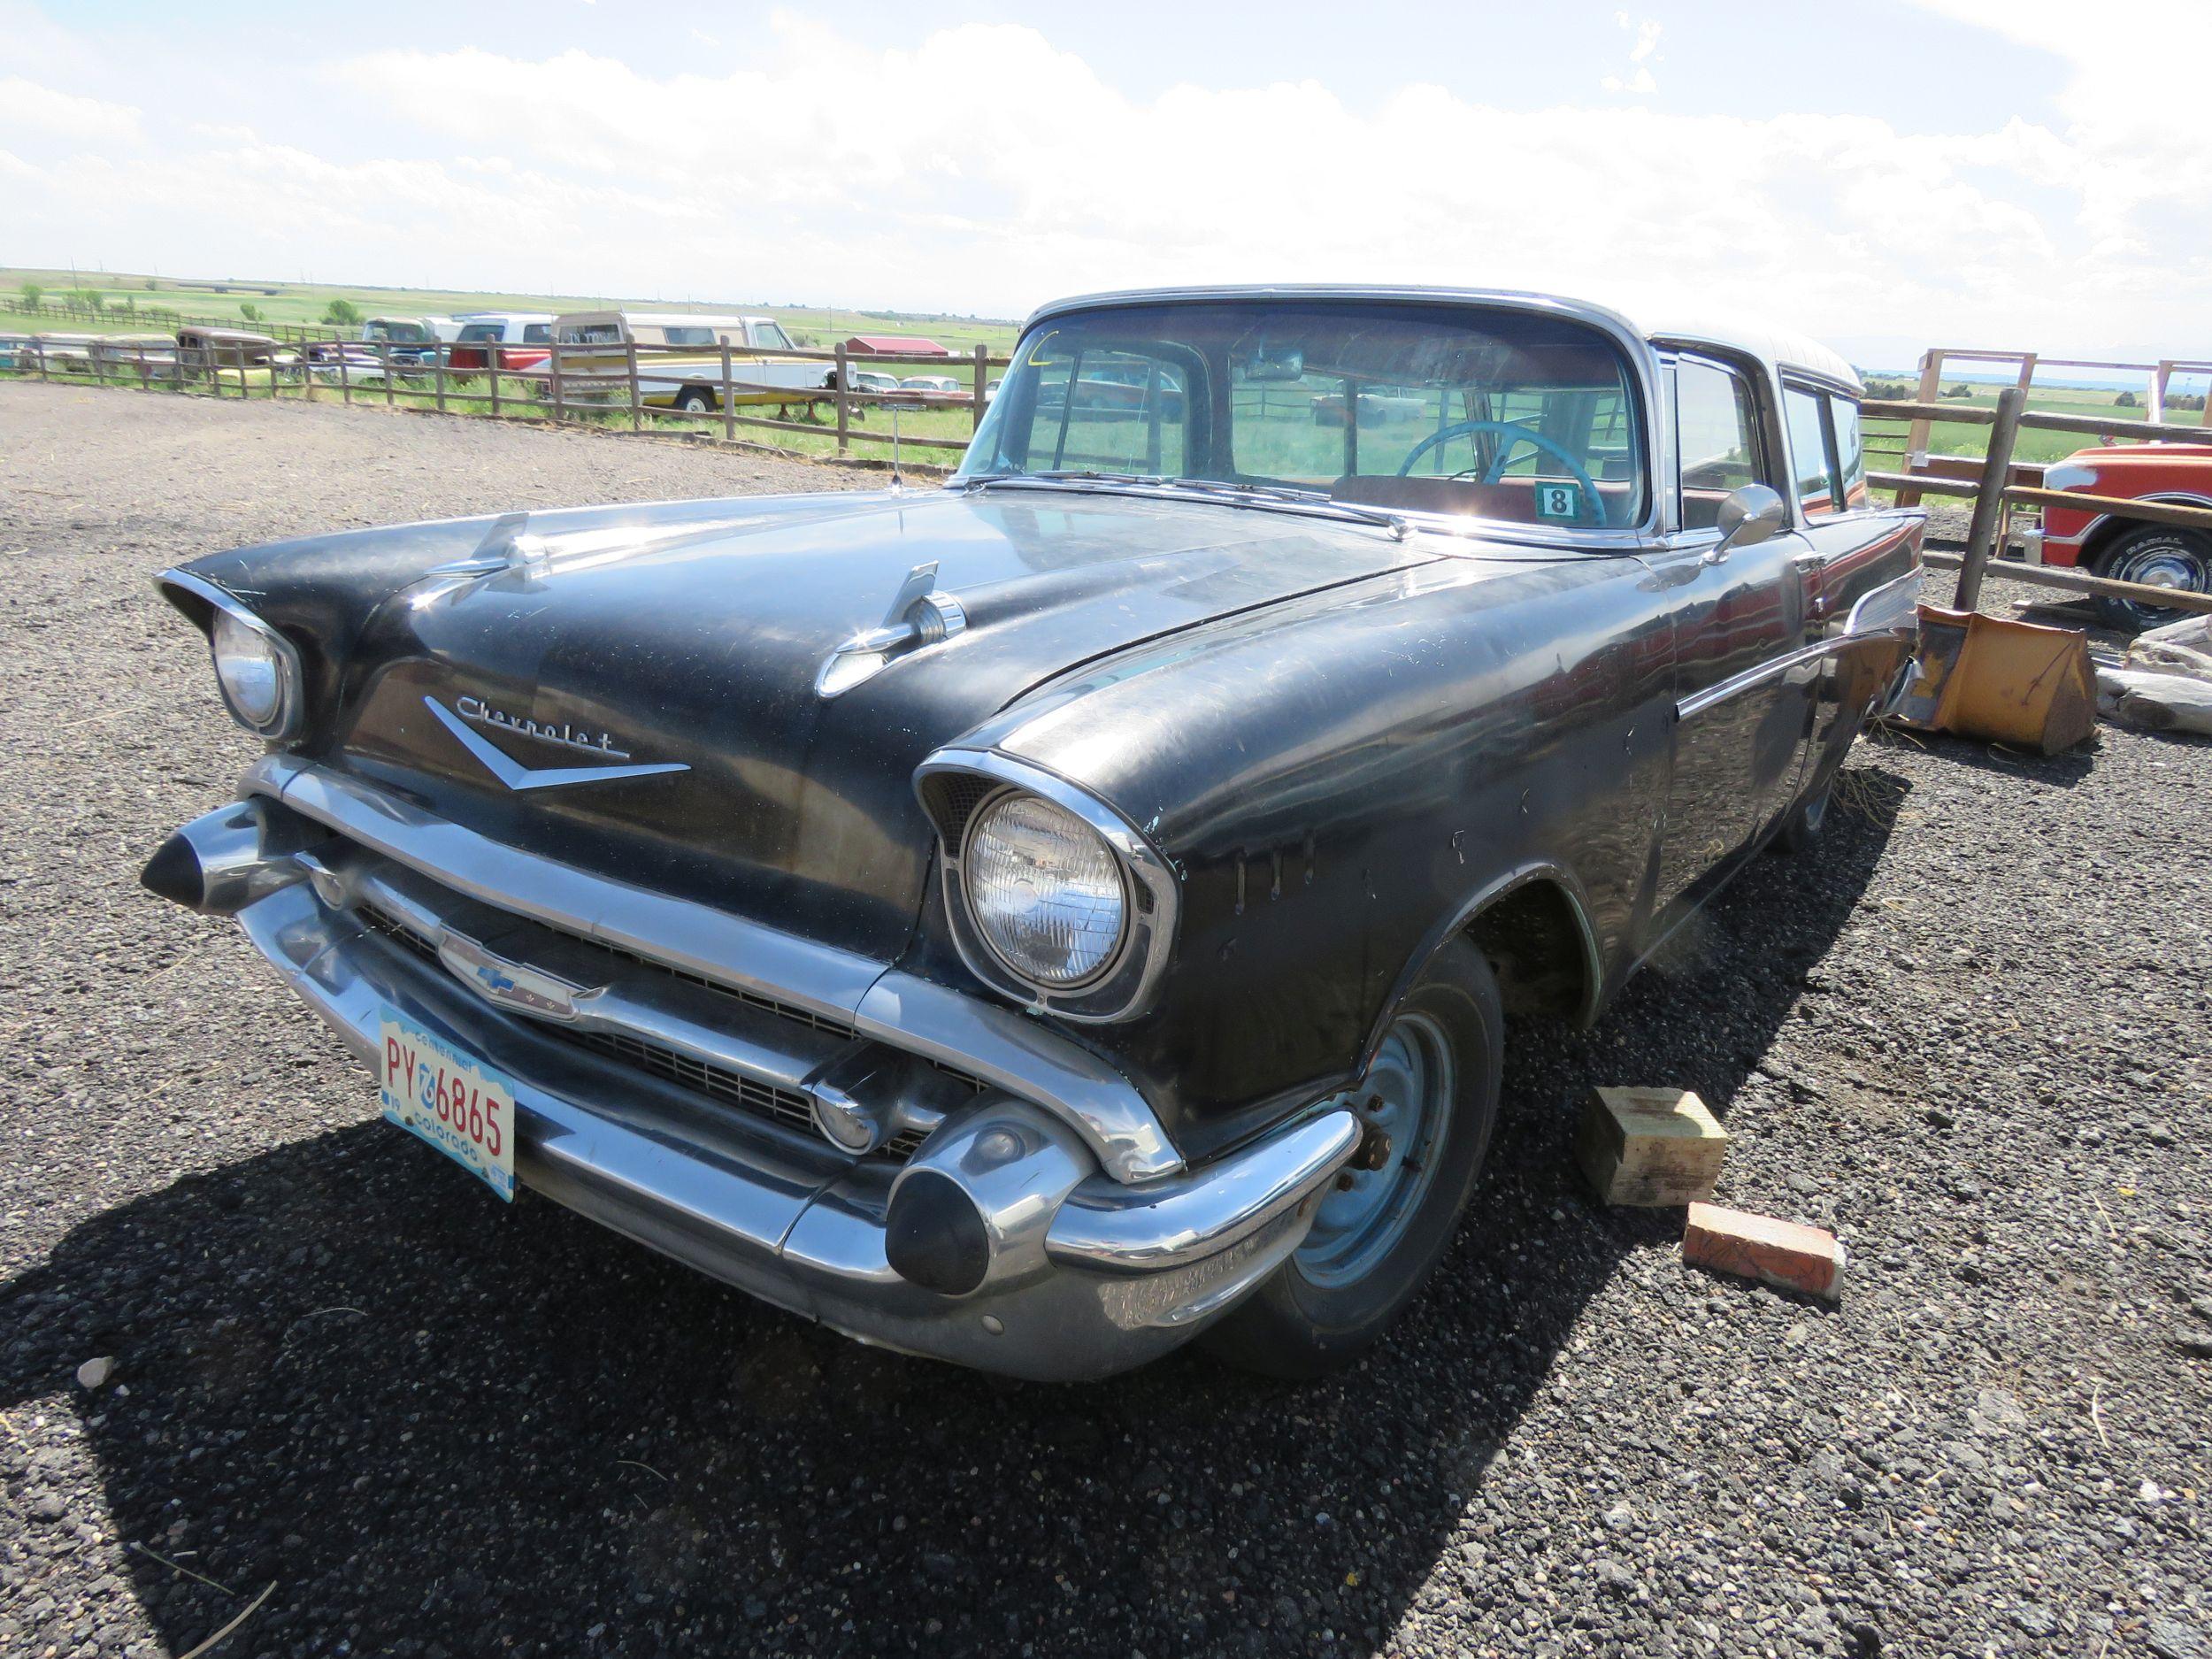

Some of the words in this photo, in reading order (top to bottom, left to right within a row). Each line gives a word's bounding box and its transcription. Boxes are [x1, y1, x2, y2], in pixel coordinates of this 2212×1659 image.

[1551, 489, 1567, 514] 8
[2125, 536, 2183, 556] RADIAL
[456, 695, 631, 759] Chevrolet
[388, 1035, 416, 1099] PY
[435, 1067, 501, 1156] 6865
